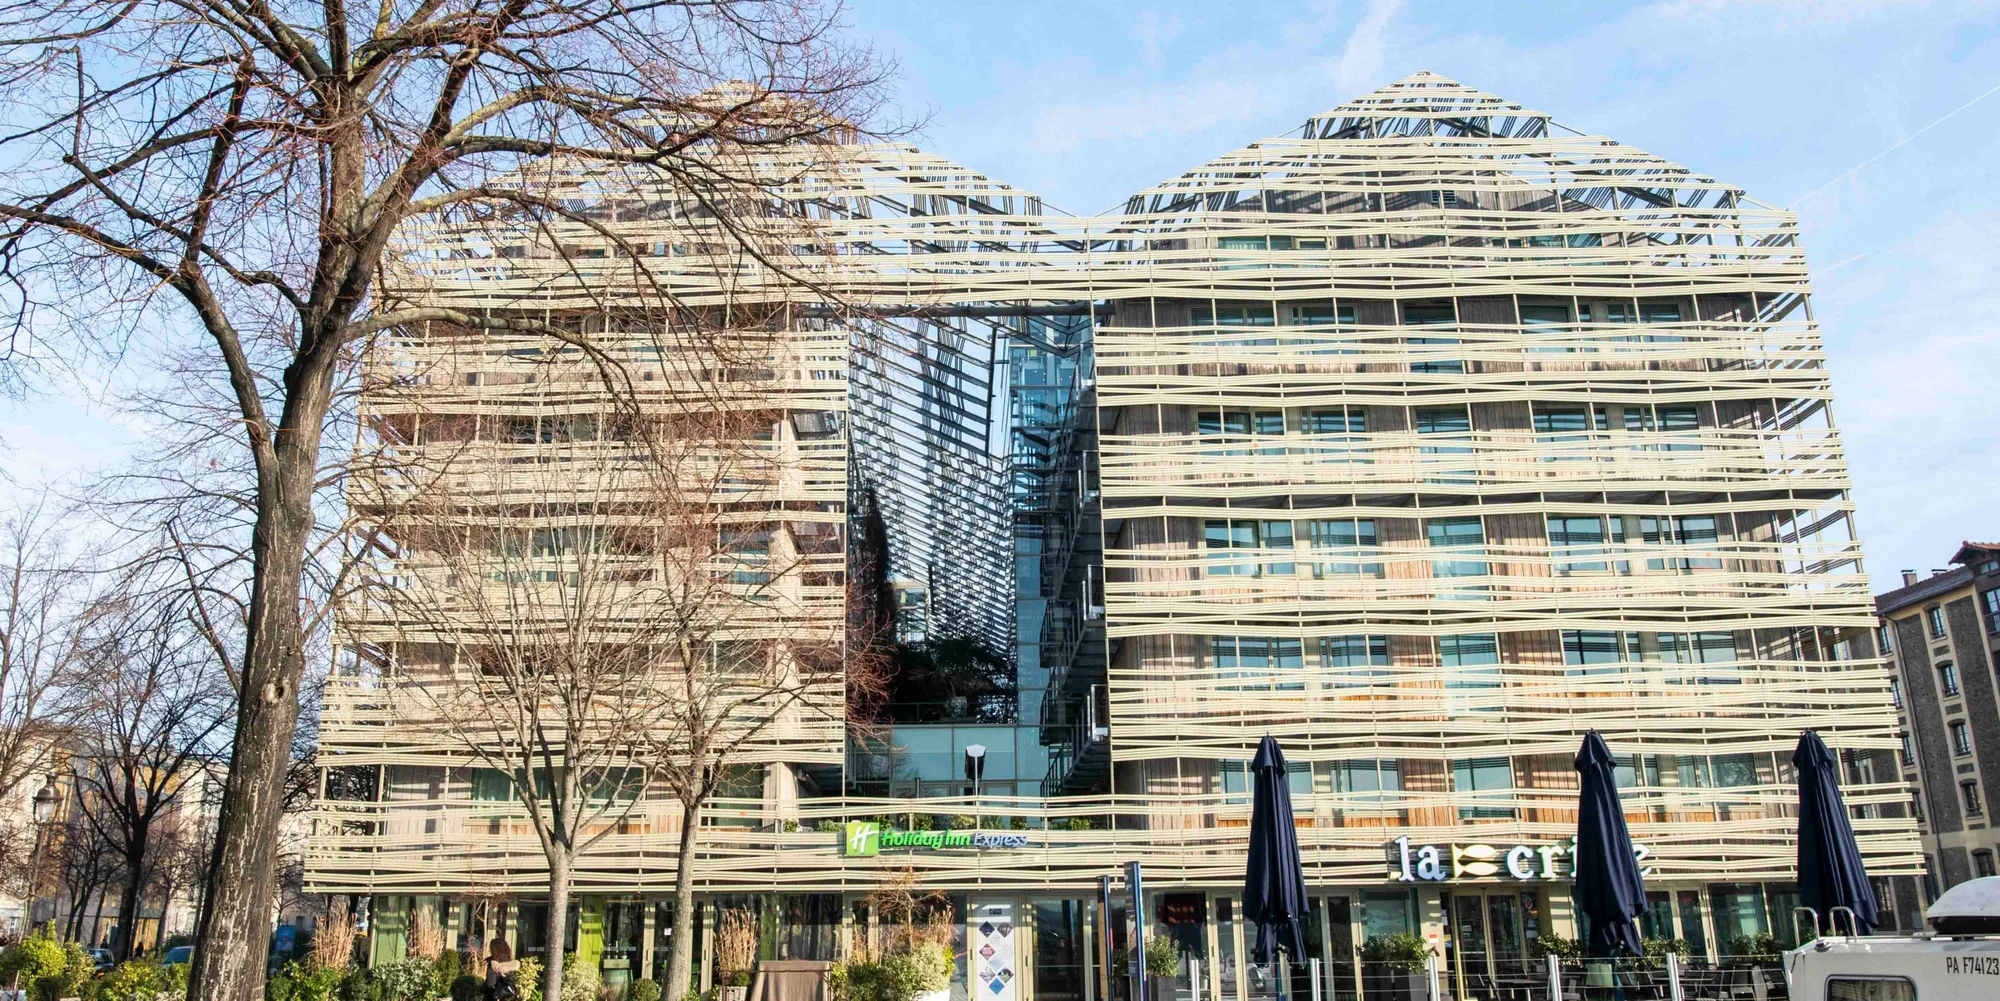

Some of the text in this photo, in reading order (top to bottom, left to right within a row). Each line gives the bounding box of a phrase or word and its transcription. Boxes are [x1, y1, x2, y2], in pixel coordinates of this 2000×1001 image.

[882, 829, 943, 850] Holiday
[945, 829, 970, 846] Inn
[973, 831, 1028, 848] Express
[1395, 835, 1652, 881] la crie
[1946, 956, 2000, 976] PA F74123
